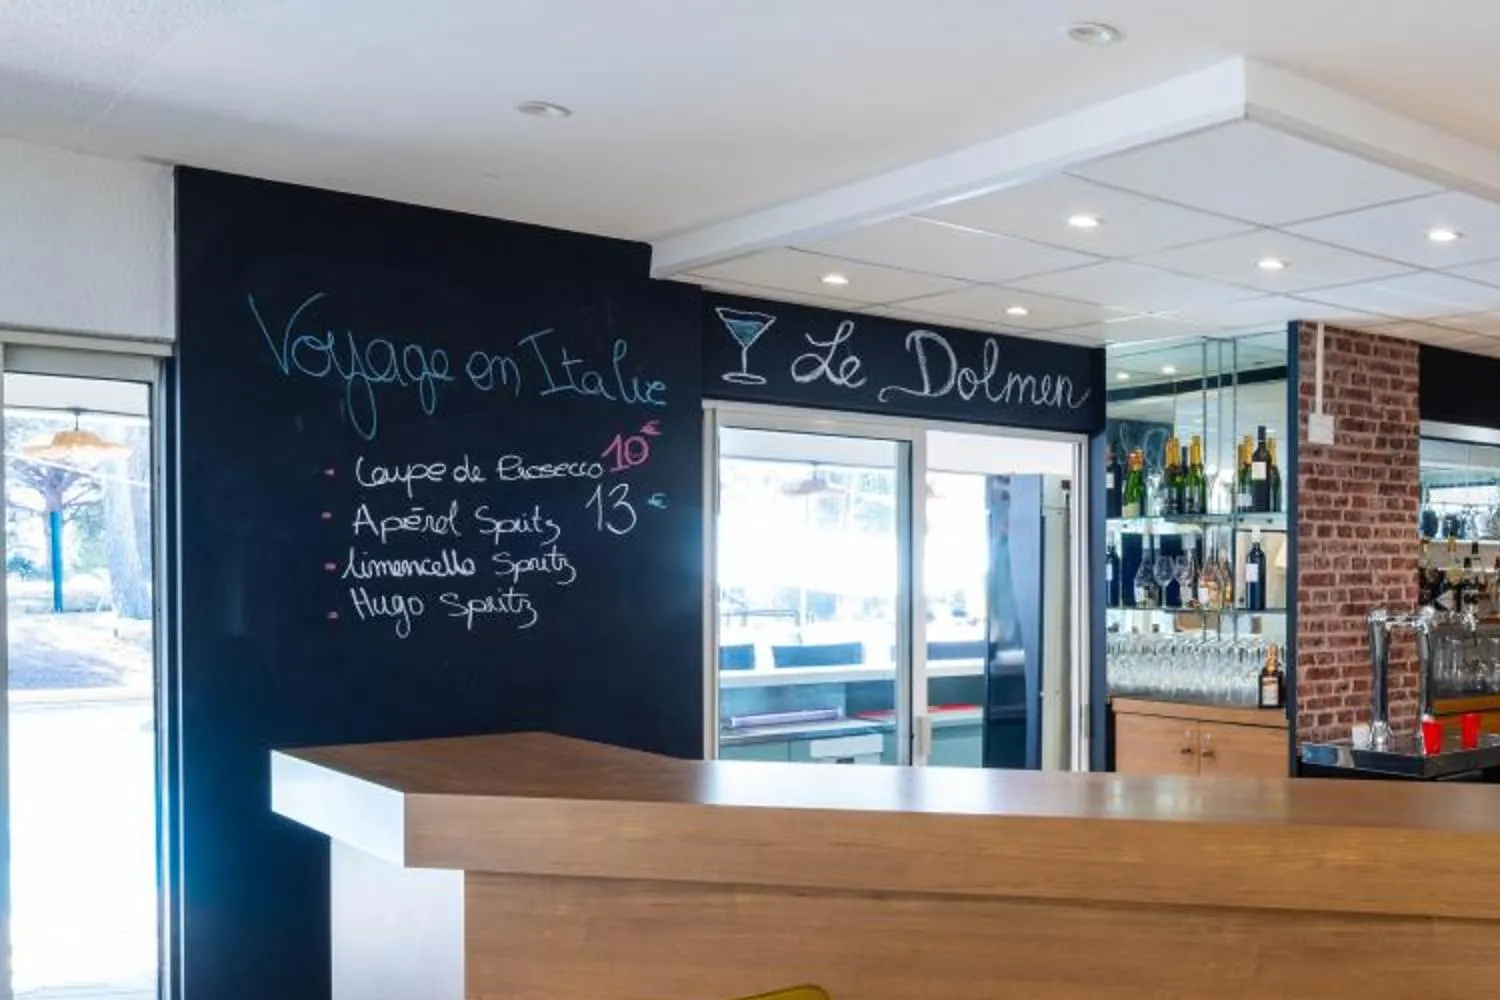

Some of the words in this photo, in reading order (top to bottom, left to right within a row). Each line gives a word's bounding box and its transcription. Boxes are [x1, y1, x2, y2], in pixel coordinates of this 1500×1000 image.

[248, 293, 454, 440] Voyage
[519, 328, 667, 405] Italie
[791, 320, 867, 388] Le
[878, 330, 1088, 408] Dolmen
[356, 456, 447, 499] Coupe
[452, 454, 487, 483] de
[350, 587, 424, 638] Hugo
[439, 587, 538, 631] Spritz
